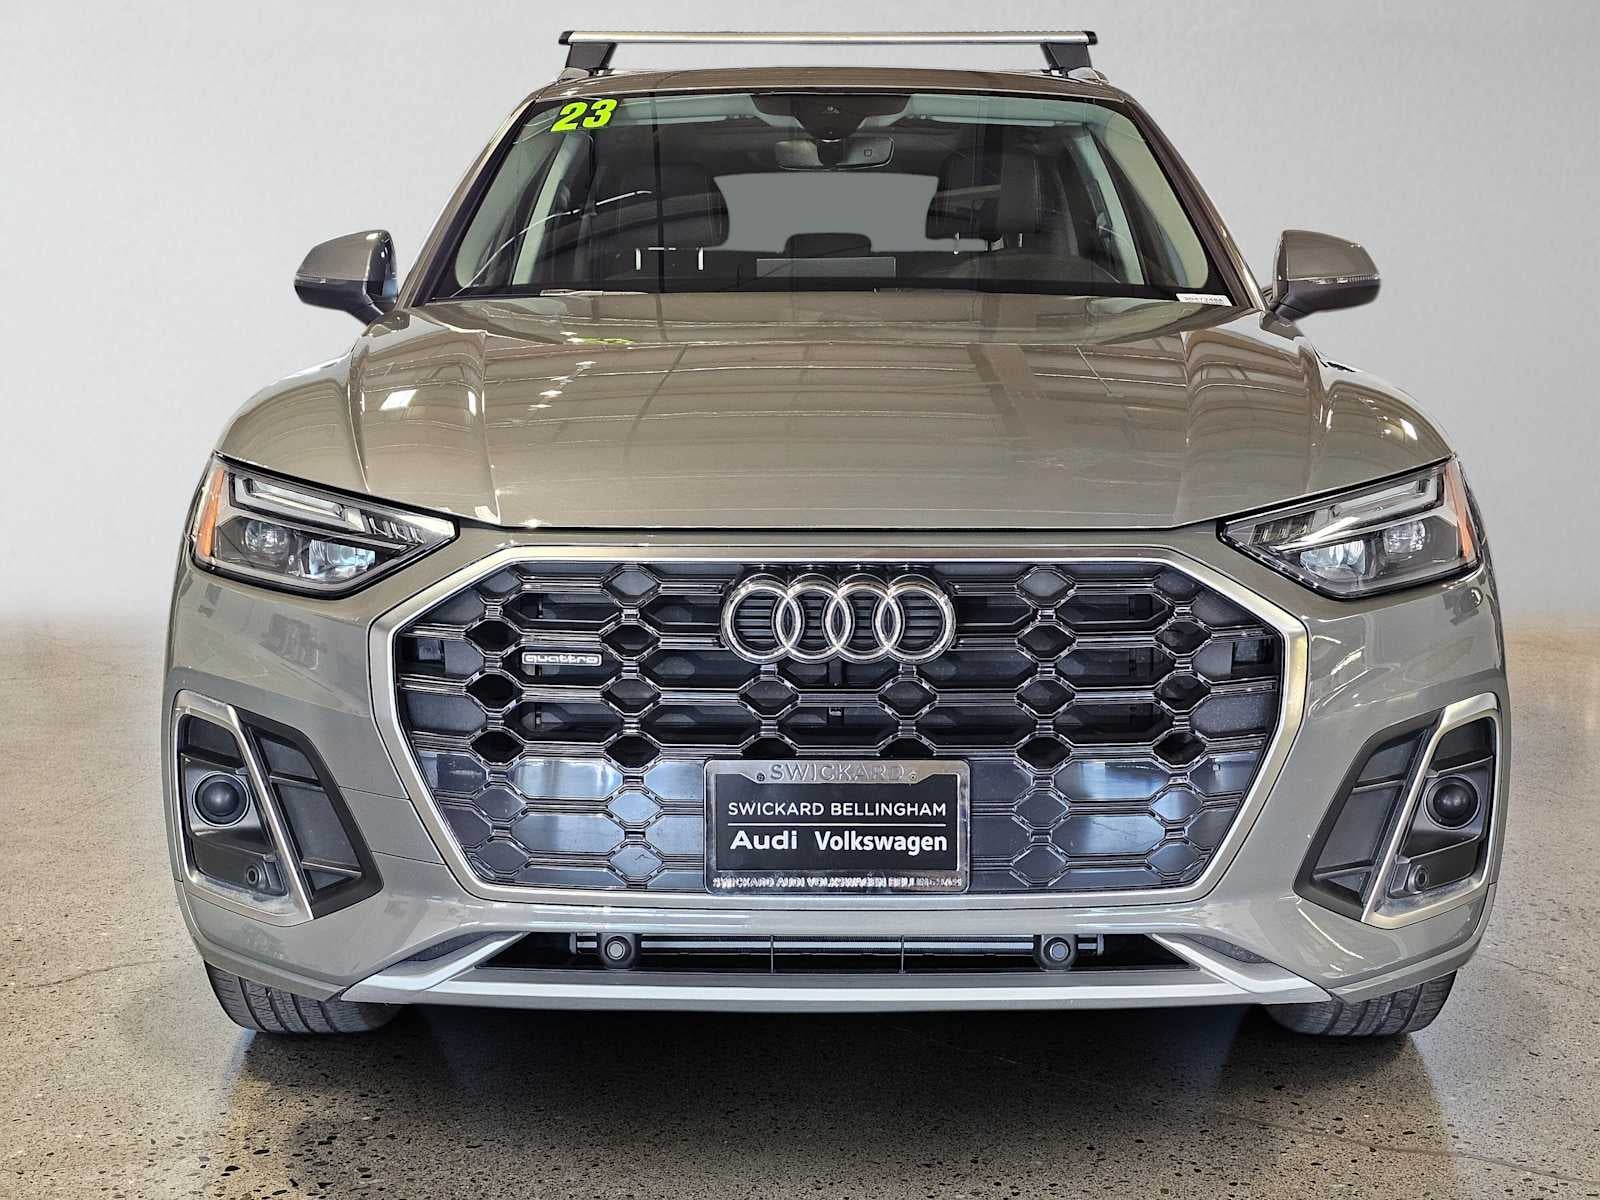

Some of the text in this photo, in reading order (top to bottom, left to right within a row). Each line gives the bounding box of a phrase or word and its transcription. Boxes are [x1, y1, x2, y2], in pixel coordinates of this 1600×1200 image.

[550, 98, 618, 132] 23
[524, 654, 599, 664] quattro
[769, 763, 905, 781] SWICKARD
[728, 802, 946, 816] SWICKARD BELLINGHAM
[730, 830, 948, 856] Audi Volkswagen
